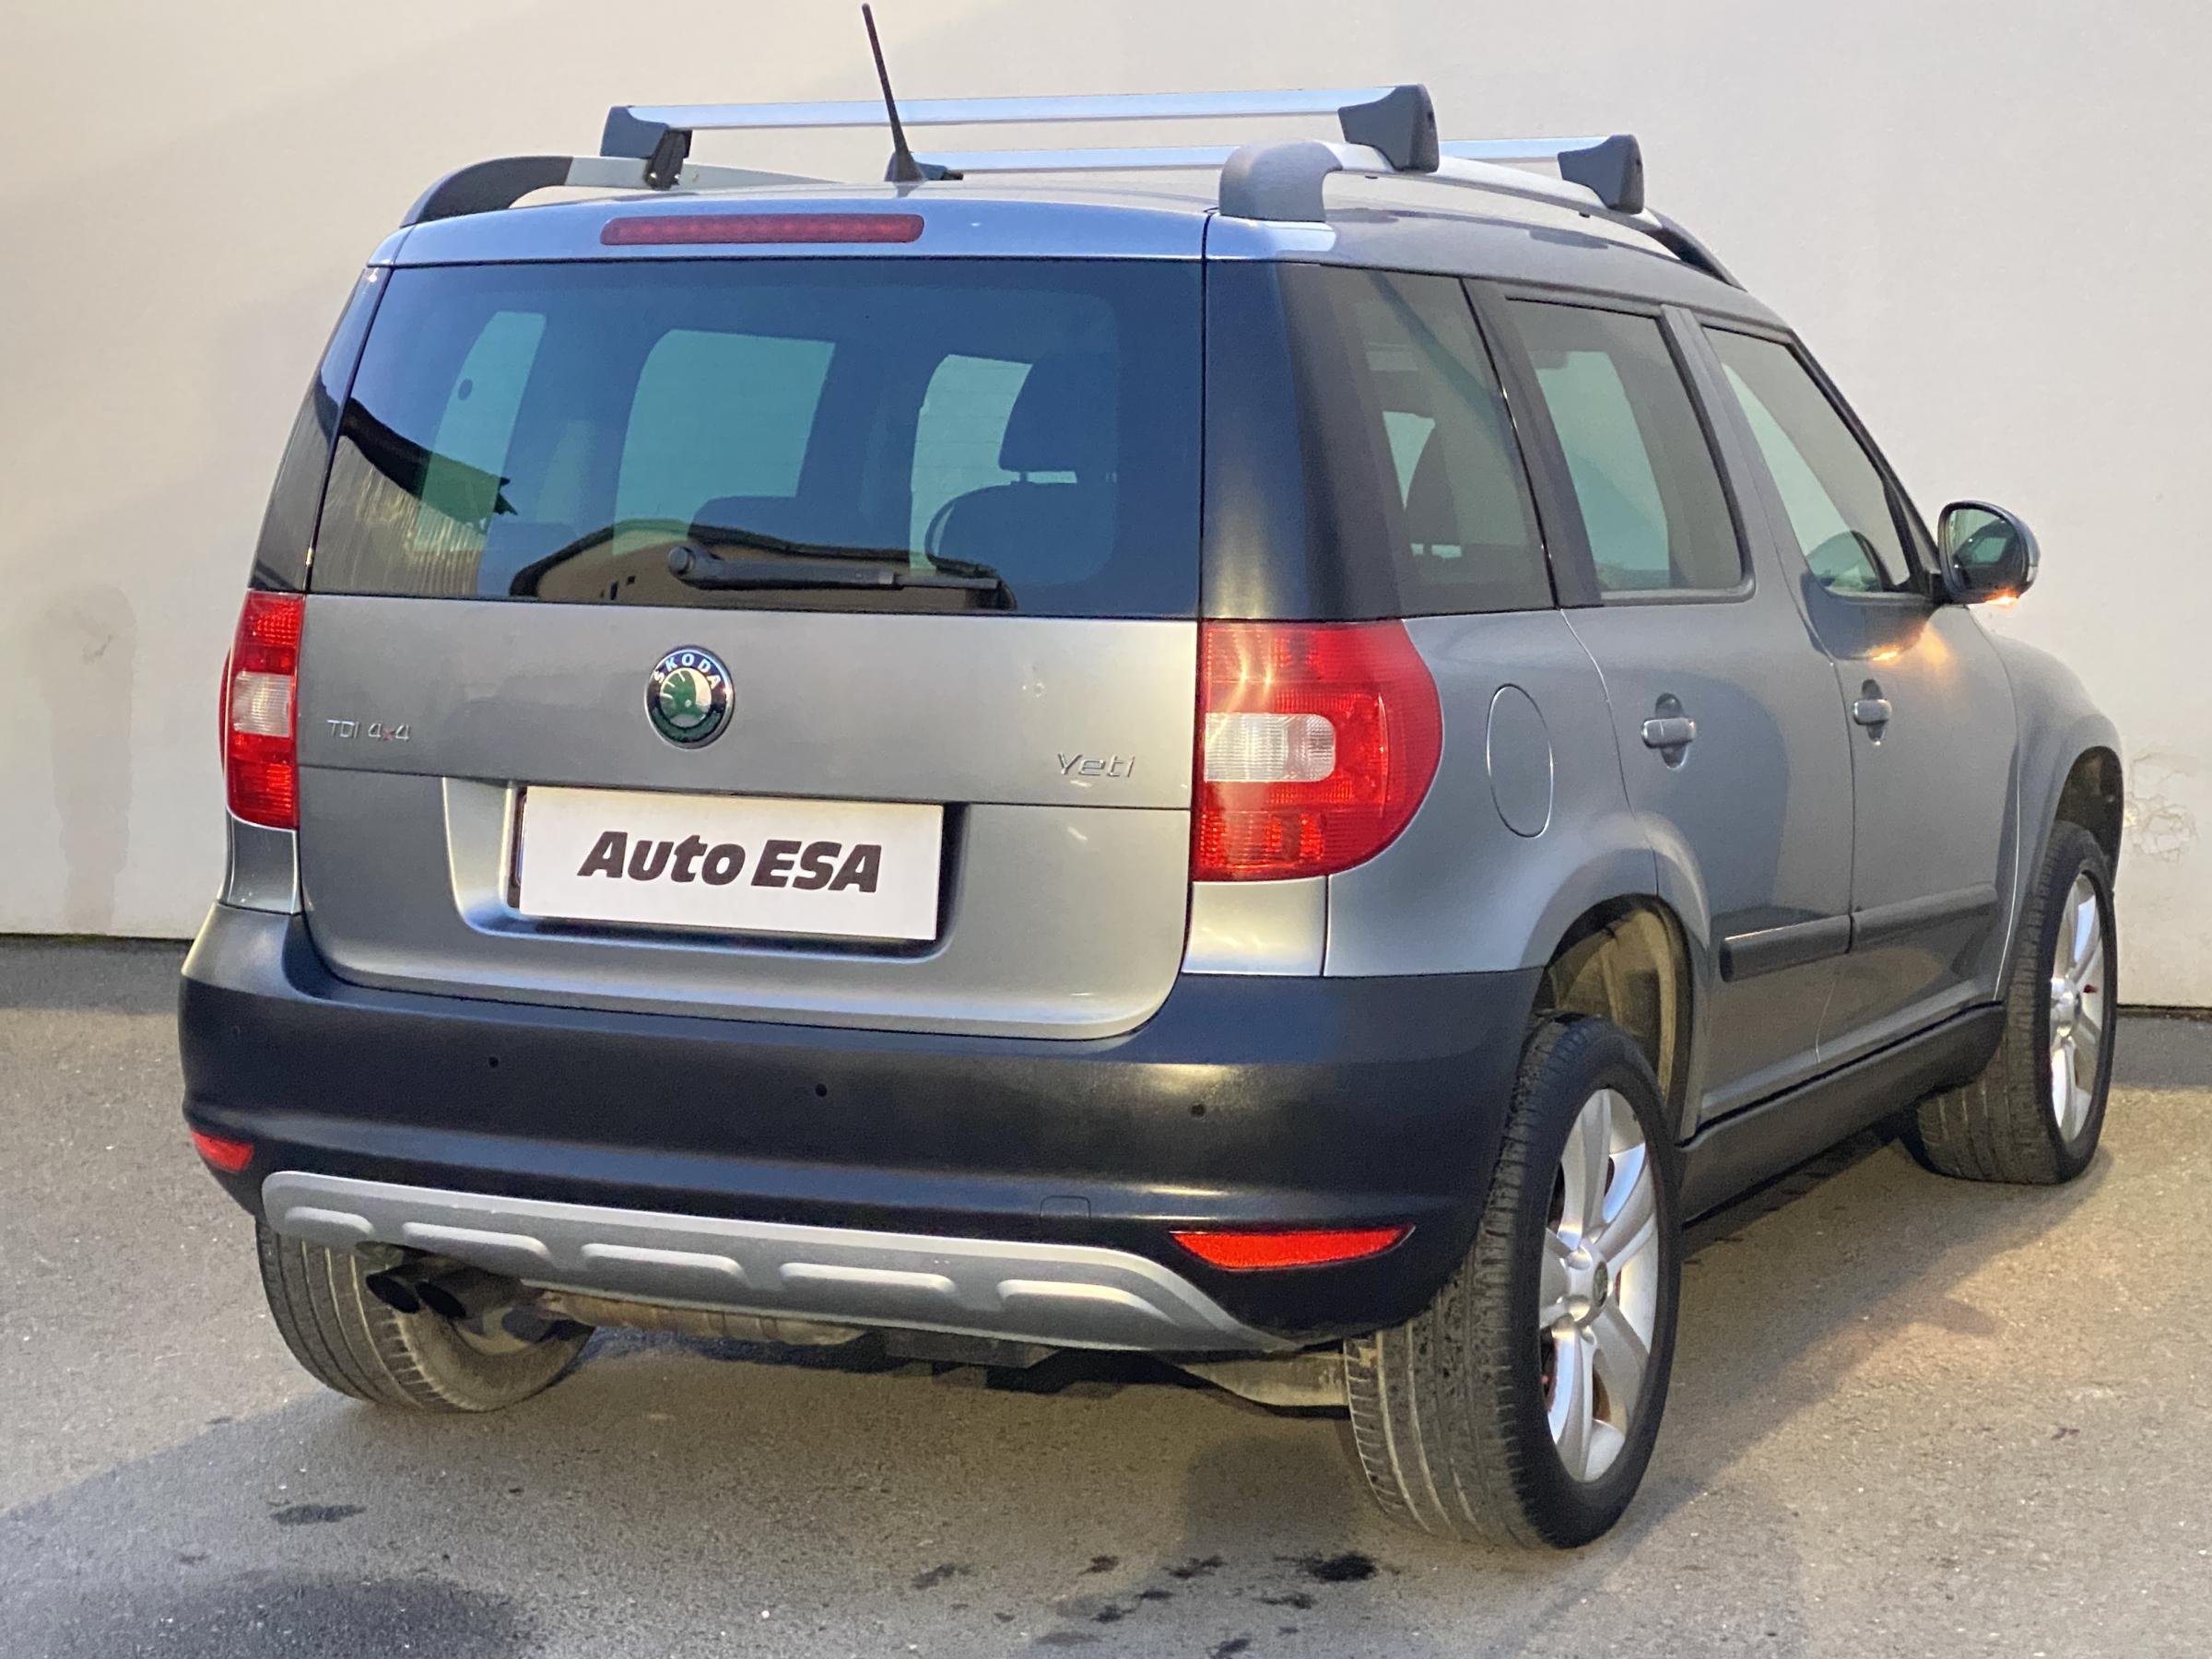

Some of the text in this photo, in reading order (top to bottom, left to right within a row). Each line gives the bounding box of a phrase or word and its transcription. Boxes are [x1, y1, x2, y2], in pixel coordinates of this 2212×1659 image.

[326, 719, 410, 741] TDI 4x4
[1057, 752, 1135, 778] Yeti
[577, 831, 882, 893] Auto ESA
